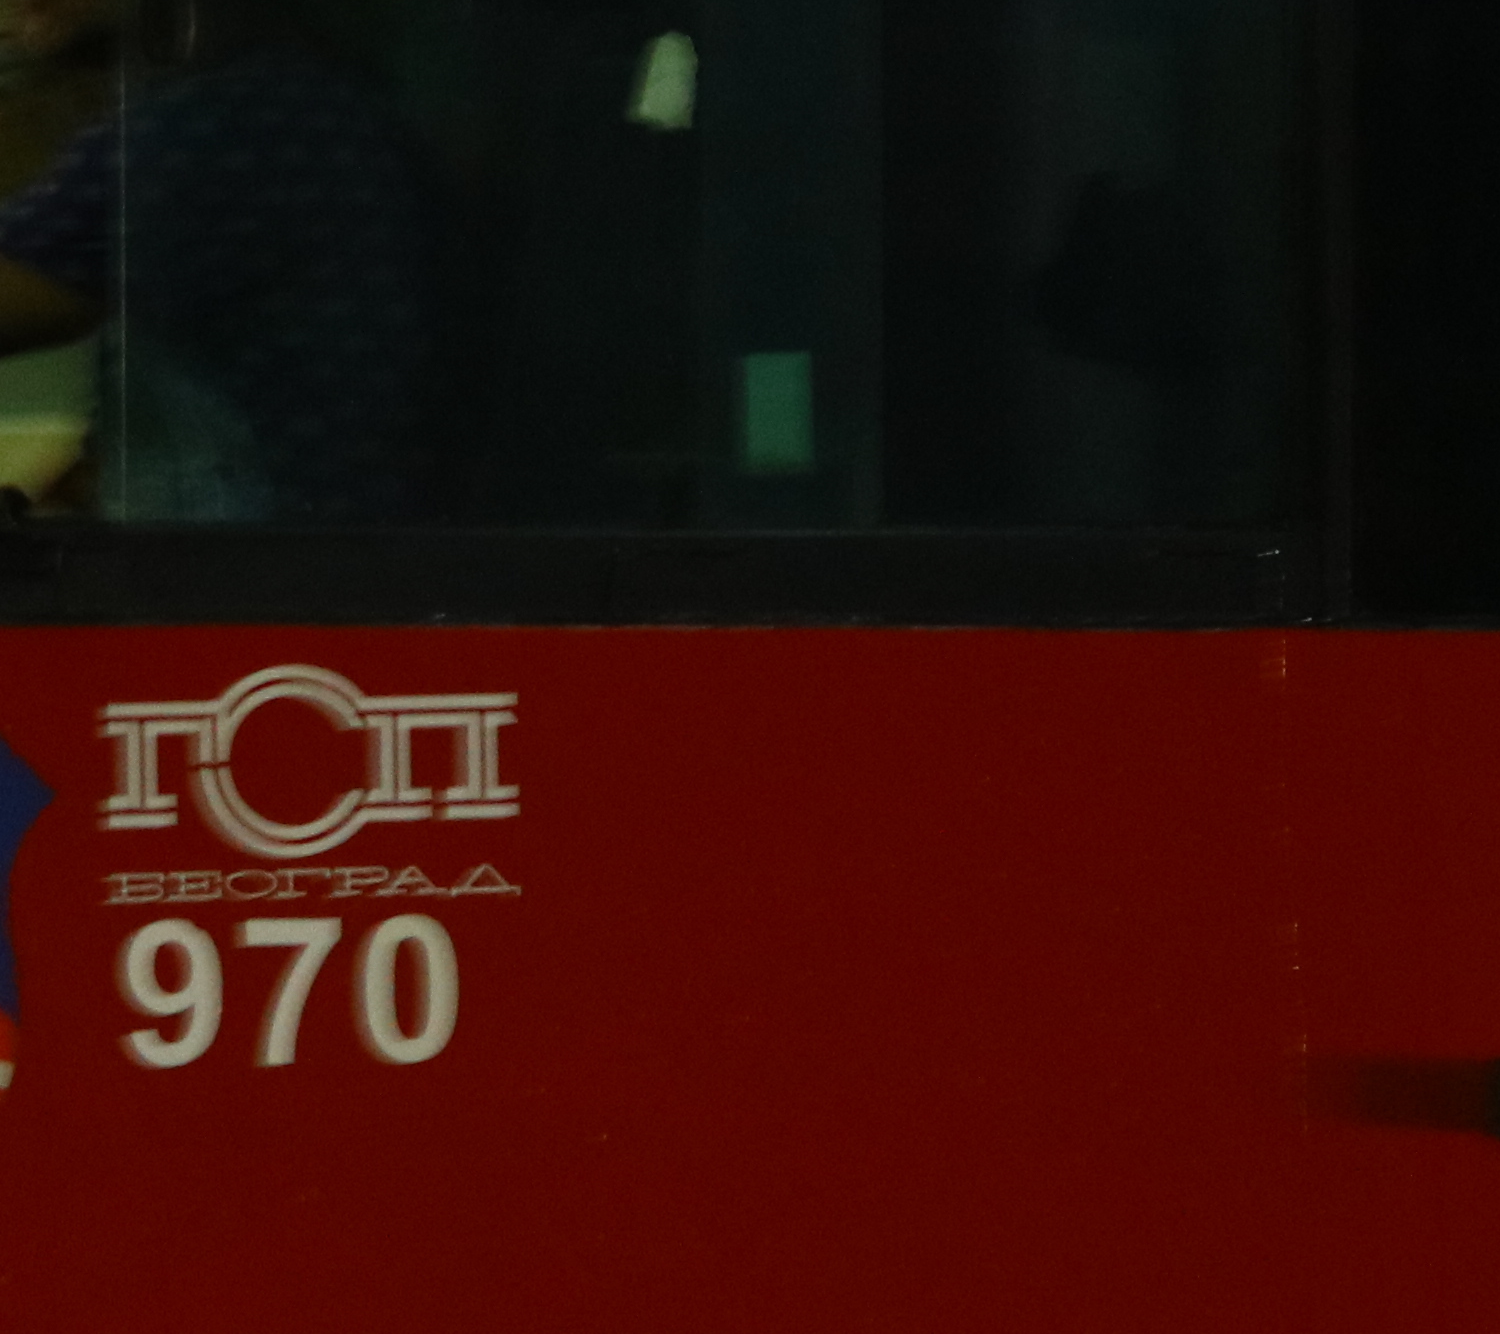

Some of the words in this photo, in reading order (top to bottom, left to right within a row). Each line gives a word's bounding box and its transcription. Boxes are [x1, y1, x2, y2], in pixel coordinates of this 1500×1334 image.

[98, 663, 522, 860] ГСП
[102, 863, 522, 906] БЕОГРАД
[114, 912, 460, 1069] 970
